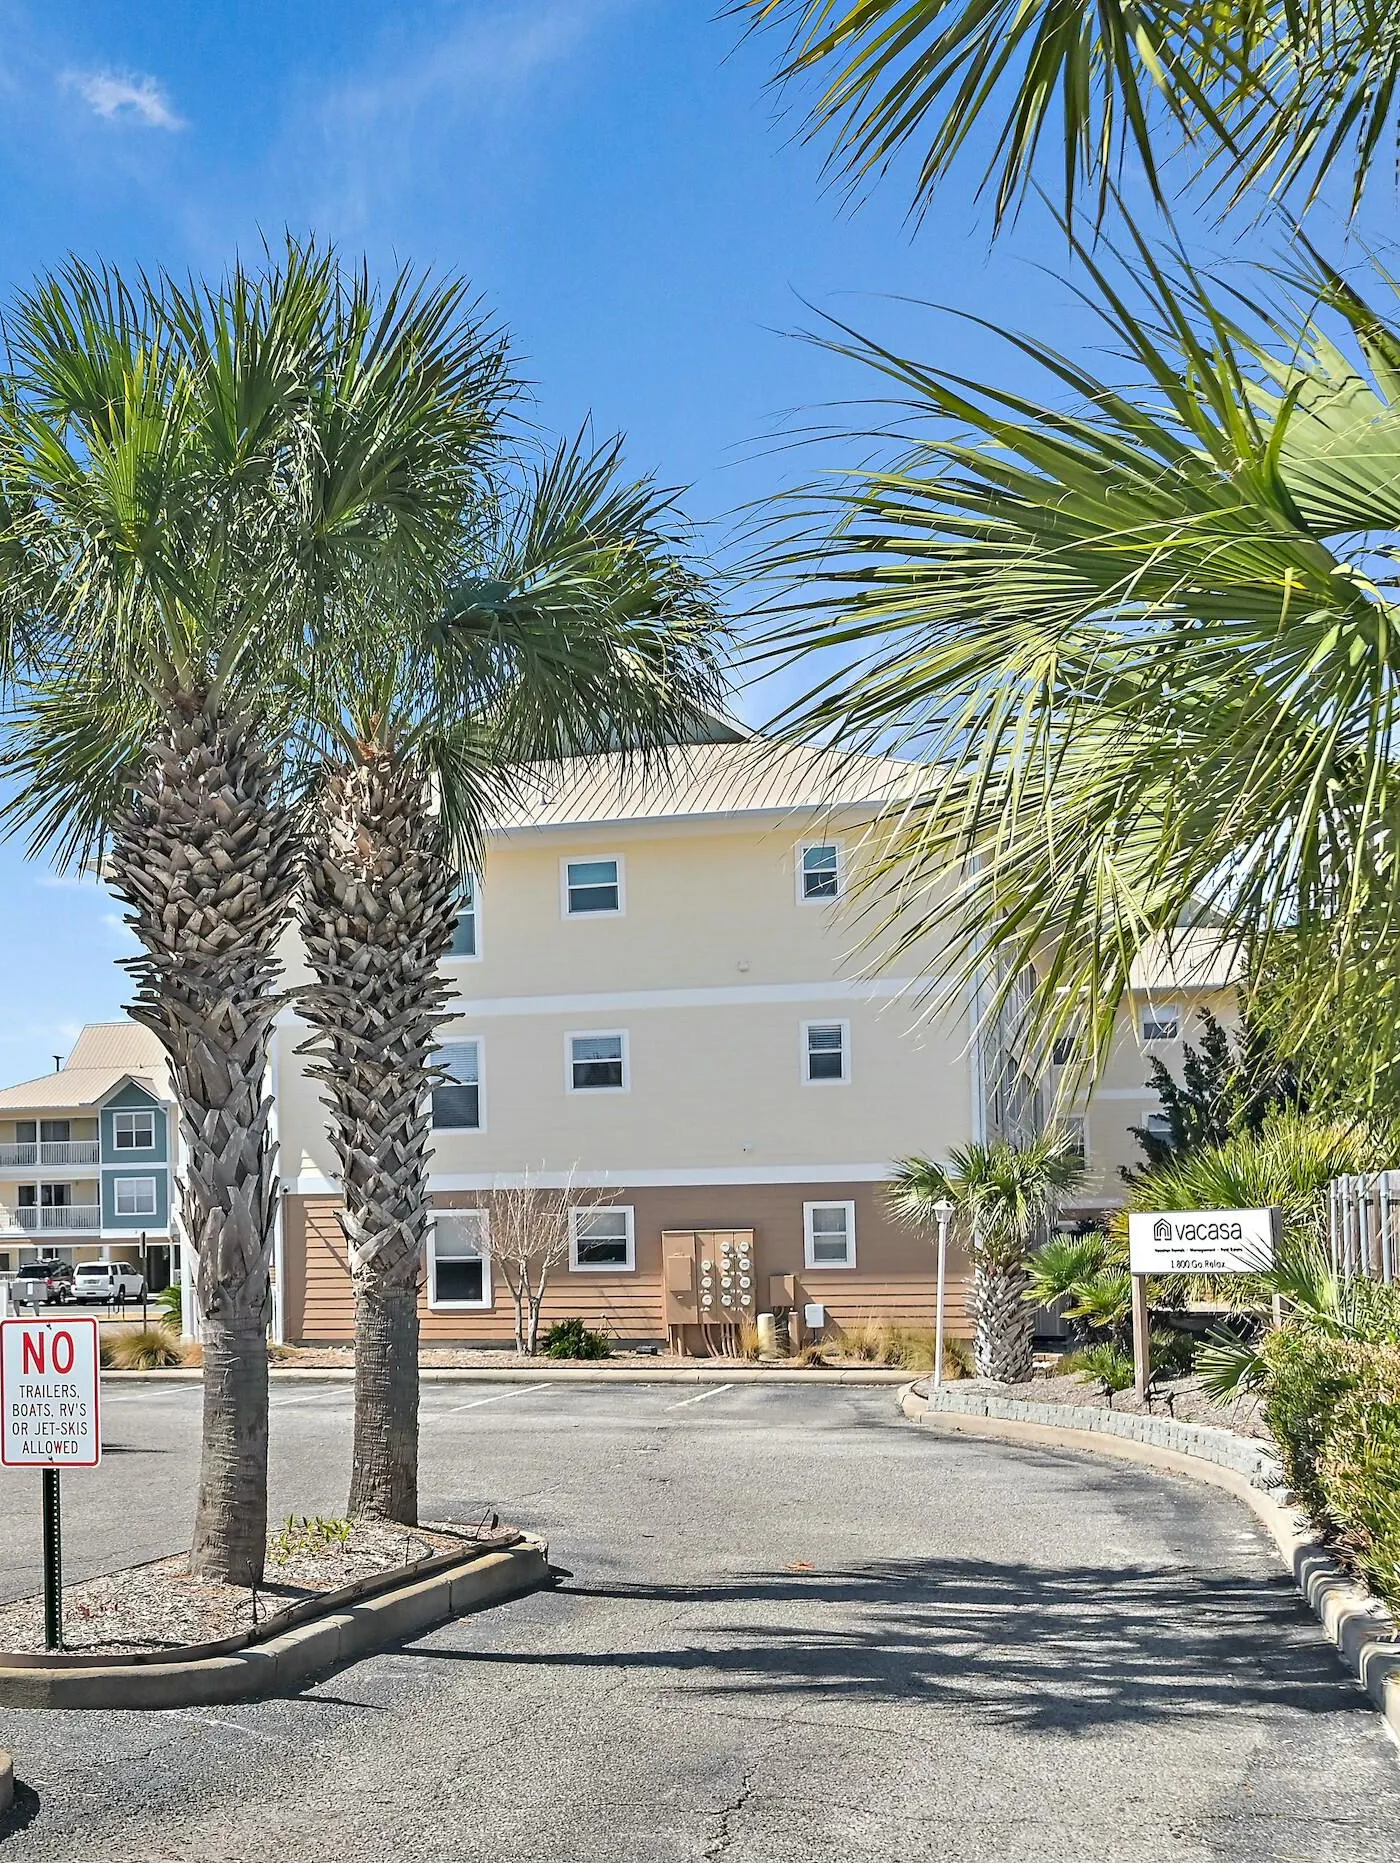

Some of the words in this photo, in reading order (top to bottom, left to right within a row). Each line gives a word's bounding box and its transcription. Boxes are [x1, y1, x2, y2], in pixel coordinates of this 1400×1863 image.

[1175, 1222, 1242, 1241] vacasa
[22, 1331, 74, 1375] NO
[19, 1384, 80, 1399] TRAILERS,
[12, 1403, 54, 1418] BOATS,
[59, 1402, 87, 1417] RV'S
[12, 1422, 28, 1436] OR
[34, 1421, 88, 1436] JET-SKIS
[22, 1440, 78, 1454] ALLOWED
